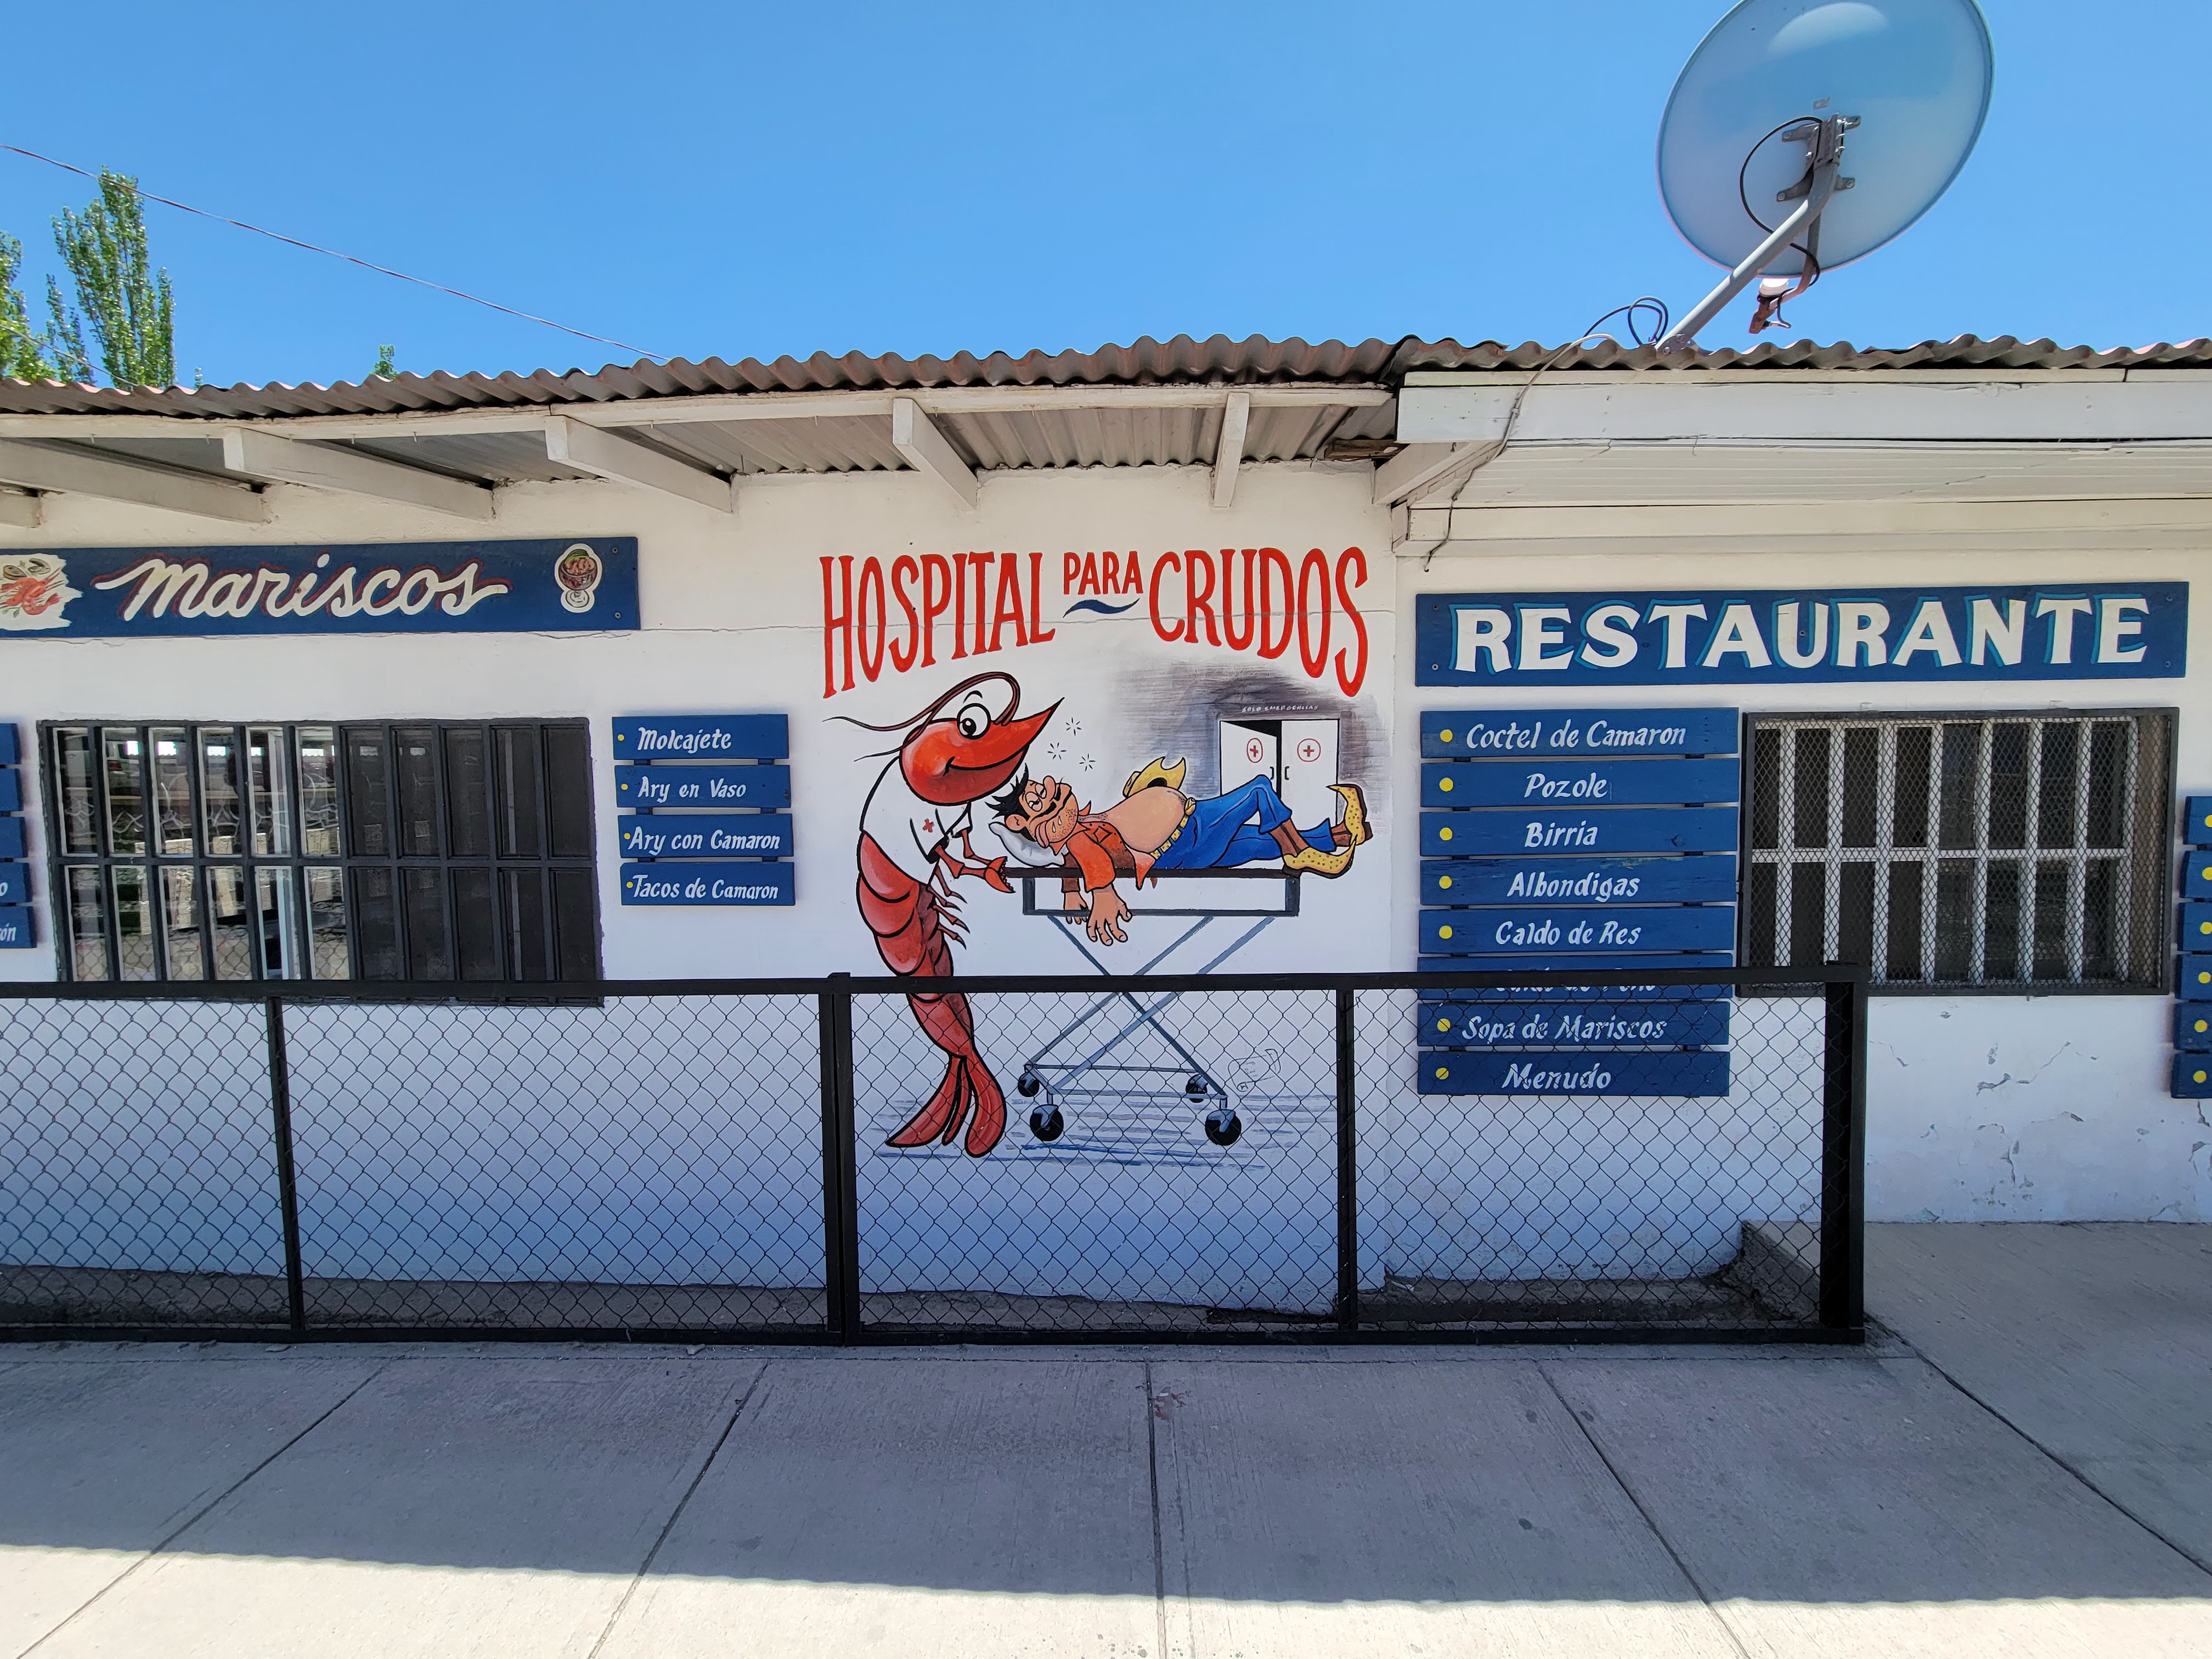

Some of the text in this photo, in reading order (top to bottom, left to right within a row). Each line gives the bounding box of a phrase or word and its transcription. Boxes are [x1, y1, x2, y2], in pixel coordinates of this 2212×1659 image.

[94, 552, 510, 621] Mariscos
[820, 546, 1368, 698] HOSPITAL PARA CRUDOS
[1449, 595, 2149, 673] RESTAURANTE
[637, 727, 731, 753] Molcajete
[1467, 719, 1685, 749] Coctel de Camaron
[638, 776, 746, 803] Ary en Vaso
[1525, 772, 1606, 798] Pozole
[628, 826, 780, 855] Ary con Camaron
[1525, 821, 1598, 847] Birria
[633, 875, 778, 899] Tacos de Camaron
[1507, 872, 1640, 902] Albondigas
[1496, 919, 1641, 945] Caldo de Res
[1463, 1014, 1667, 1042] Sopa de Mariscos
[1502, 1063, 1611, 1089] Menudo
